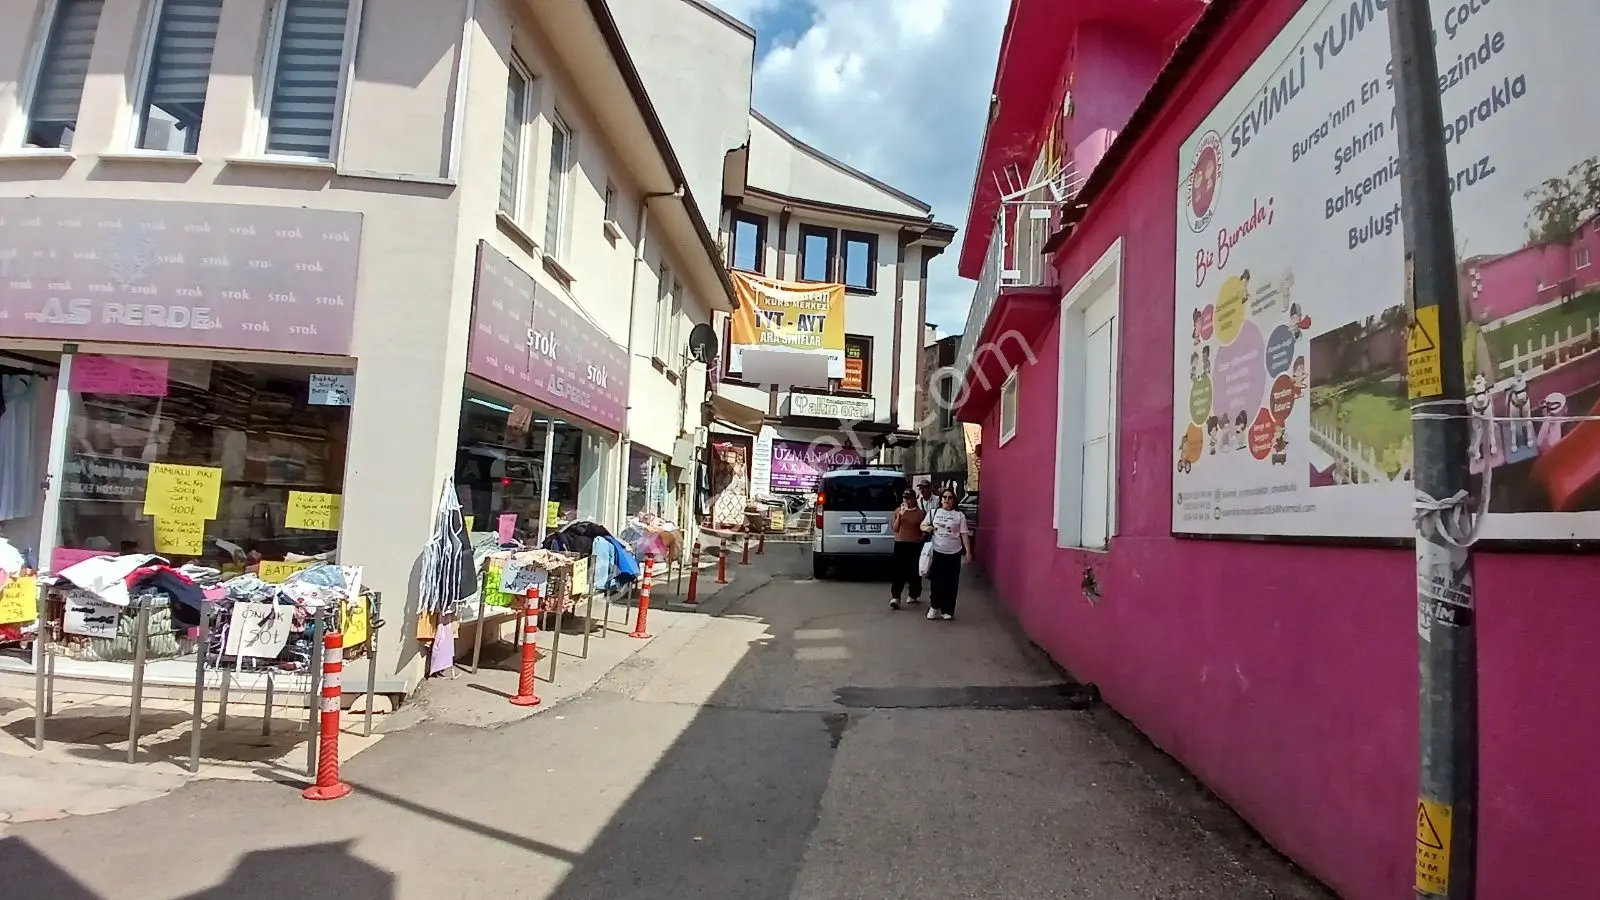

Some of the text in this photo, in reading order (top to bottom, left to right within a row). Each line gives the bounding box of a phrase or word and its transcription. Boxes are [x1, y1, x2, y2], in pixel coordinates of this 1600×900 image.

[1230, 0, 1389, 158] SEVİMLİ YUM
[1292, 78, 1380, 163] Bursa'nın En
[1334, 121, 1385, 176] Şehrin
[36, 297, 92, 326] AS
[101, 302, 212, 331] PERDE
[765, 297, 790, 307] KURS
[754, 309, 784, 329] TYT
[797, 313, 826, 333] AYT
[760, 332, 781, 344] ARA
[824, 452, 861, 466] MODA
